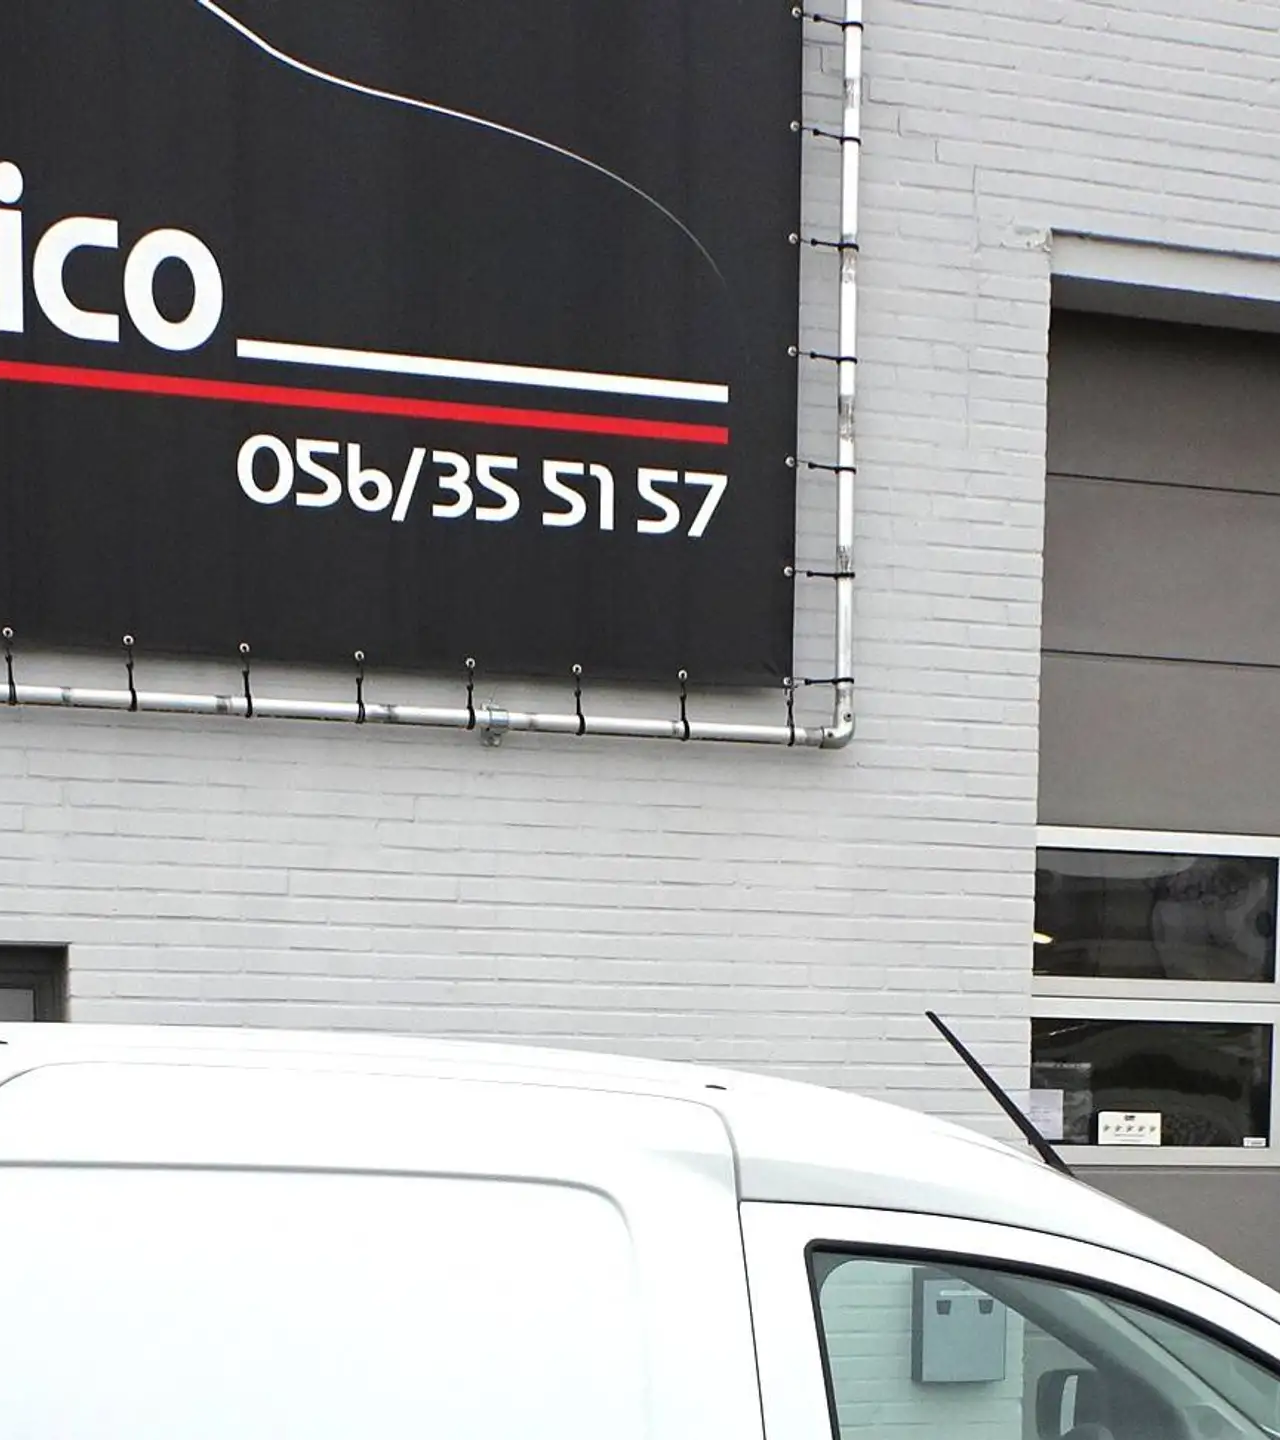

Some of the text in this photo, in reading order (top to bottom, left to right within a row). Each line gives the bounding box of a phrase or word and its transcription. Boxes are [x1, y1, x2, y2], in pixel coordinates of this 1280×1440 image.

[237, 434, 728, 538] 056/35 51 57
